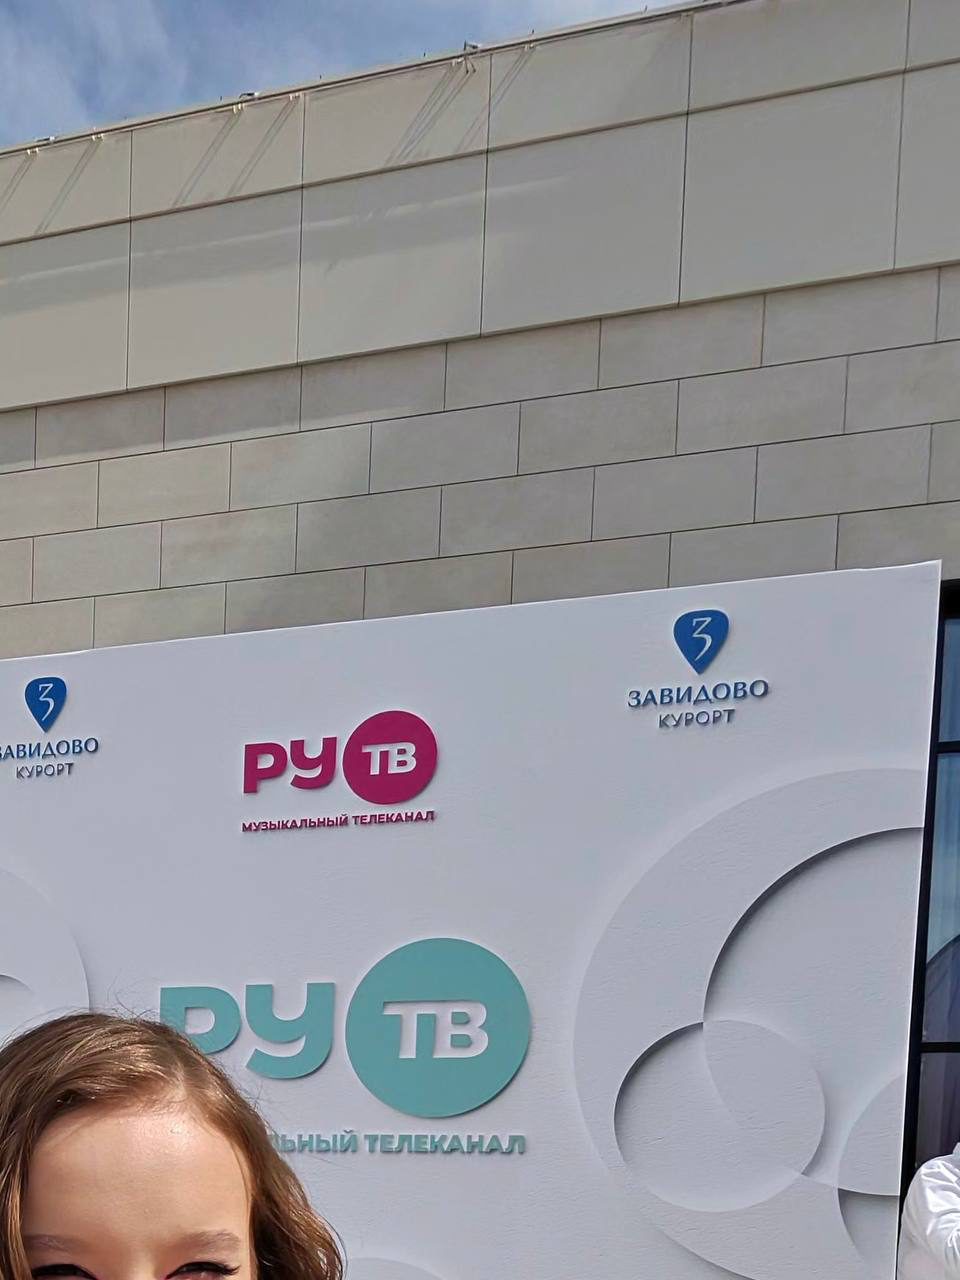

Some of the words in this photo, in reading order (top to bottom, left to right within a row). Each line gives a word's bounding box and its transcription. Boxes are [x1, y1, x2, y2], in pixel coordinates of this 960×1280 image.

[628, 679, 770, 708] ЗАВИДОВО
[658, 709, 736, 729] КУРОРТ
[16, 762, 74, 779] КУРОРТ
[243, 736, 338, 793] РУ
[362, 742, 417, 775] ТВ
[242, 813, 349, 832] МУЗЫКАЛЬНЫЙ
[352, 810, 435, 826] ТЕЛЕКАНАЛ
[383, 1000, 489, 1060] ТВ
[364, 1133, 526, 1154] ТЕЛЕКАНАЛ
